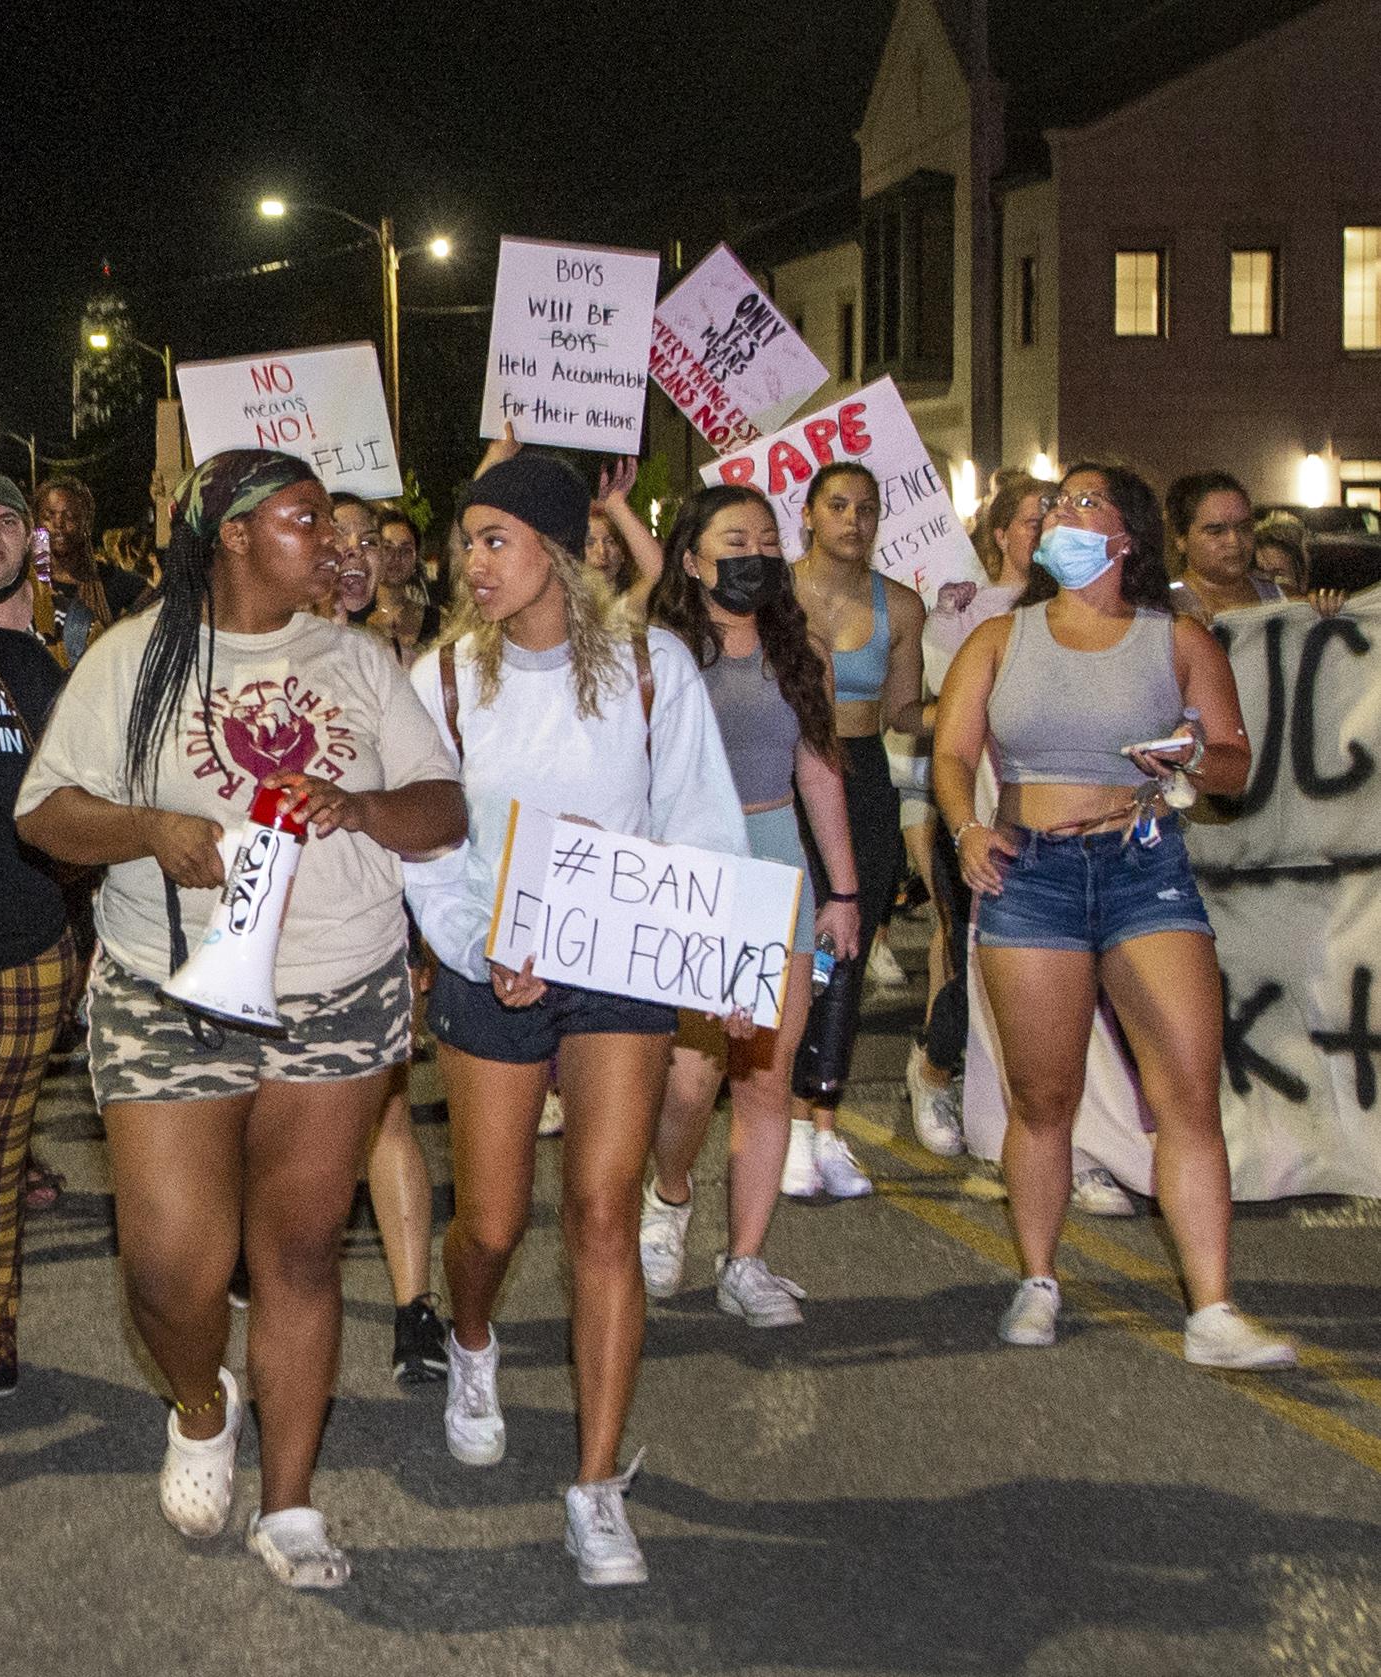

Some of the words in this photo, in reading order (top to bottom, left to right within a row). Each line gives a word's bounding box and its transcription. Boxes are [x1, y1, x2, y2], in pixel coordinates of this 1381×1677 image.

[556, 258, 604, 287] BOYS
[587, 303, 620, 326] BE
[735, 293, 787, 347] ONLY
[700, 323, 749, 376] MEANS
[719, 317, 760, 362] YES
[250, 361, 294, 395] NO
[498, 353, 537, 377] Held
[243, 396, 309, 419] means
[531, 397, 580, 424] their
[255, 413, 317, 448] NO!
[719, 402, 872, 496] RAPE
[283, 675, 357, 783] CHANGE
[509, 889, 599, 977] FIGI
[627, 923, 788, 1014] FOREVER
